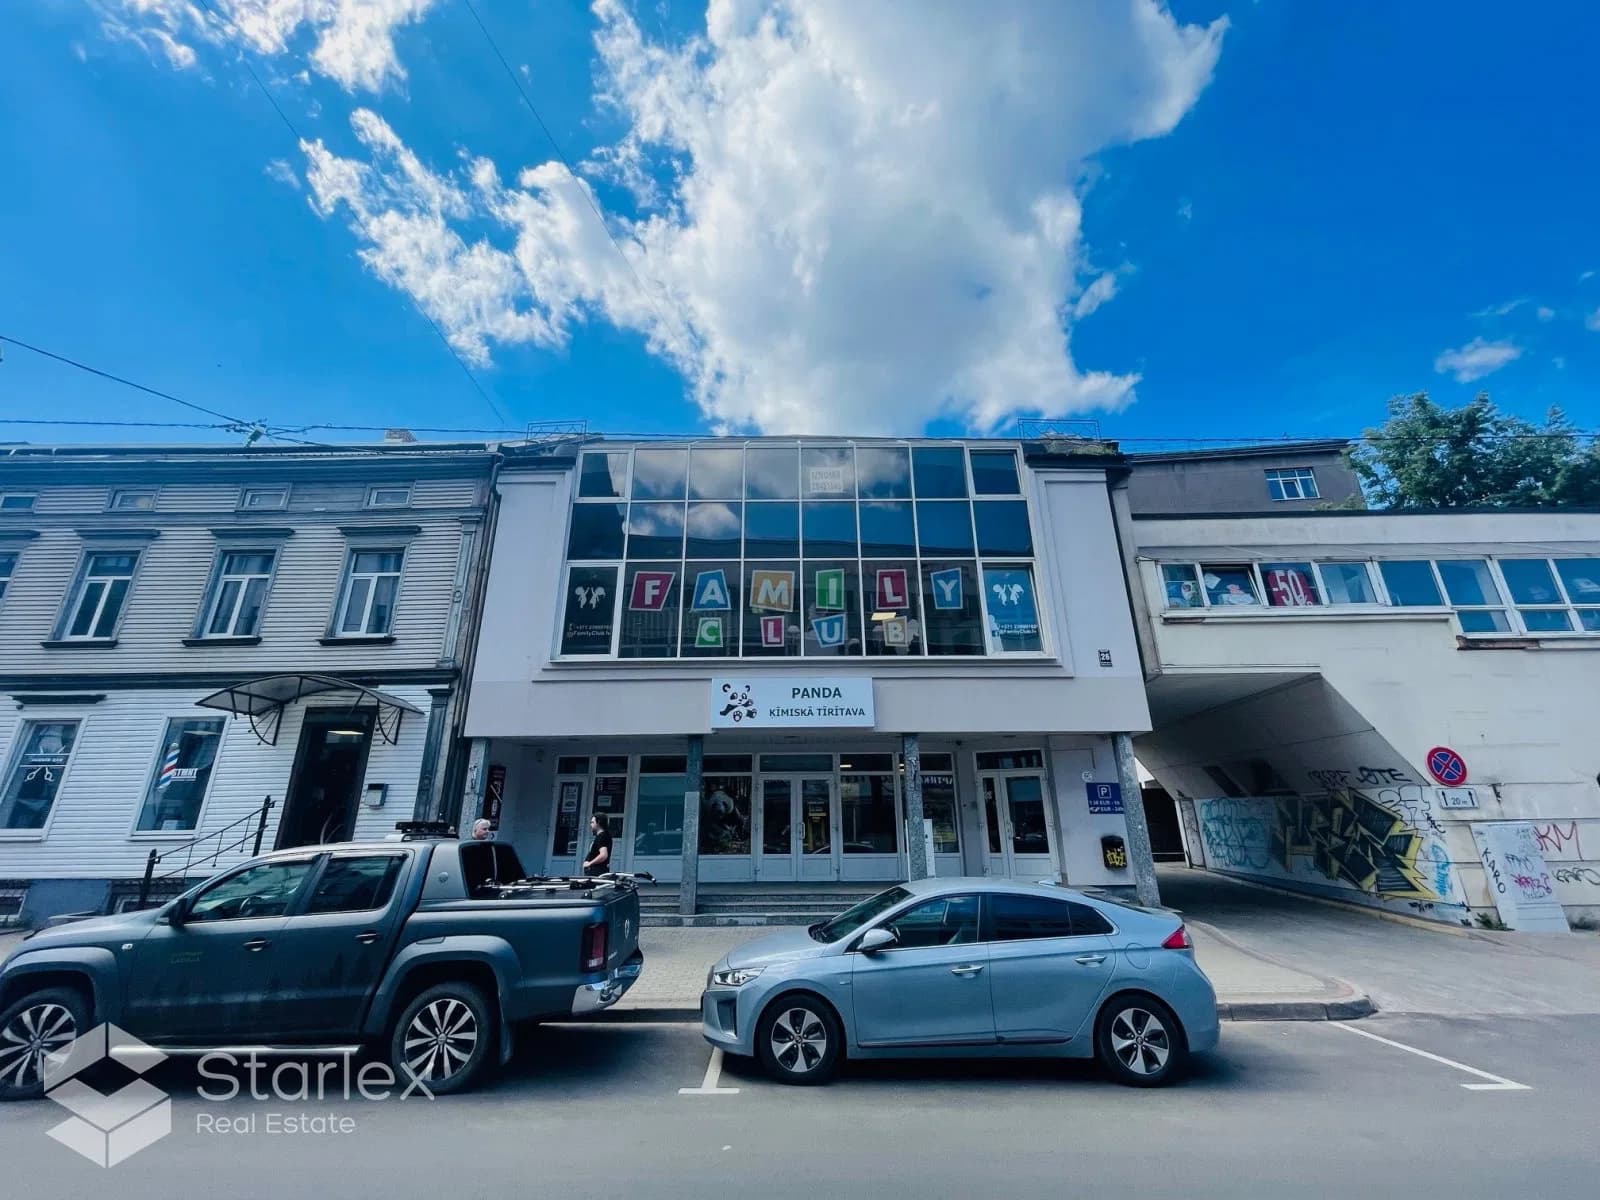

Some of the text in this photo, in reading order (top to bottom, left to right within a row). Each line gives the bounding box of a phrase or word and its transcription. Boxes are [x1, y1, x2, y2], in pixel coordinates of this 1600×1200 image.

[644, 577, 958, 605] FAMILY
[700, 620, 905, 643] CLUB
[791, 687, 843, 699] PANDA
[769, 705, 866, 719] ĶĪMISKĀ TĪRĪTAVA
[1451, 797, 1461, 805] 20
